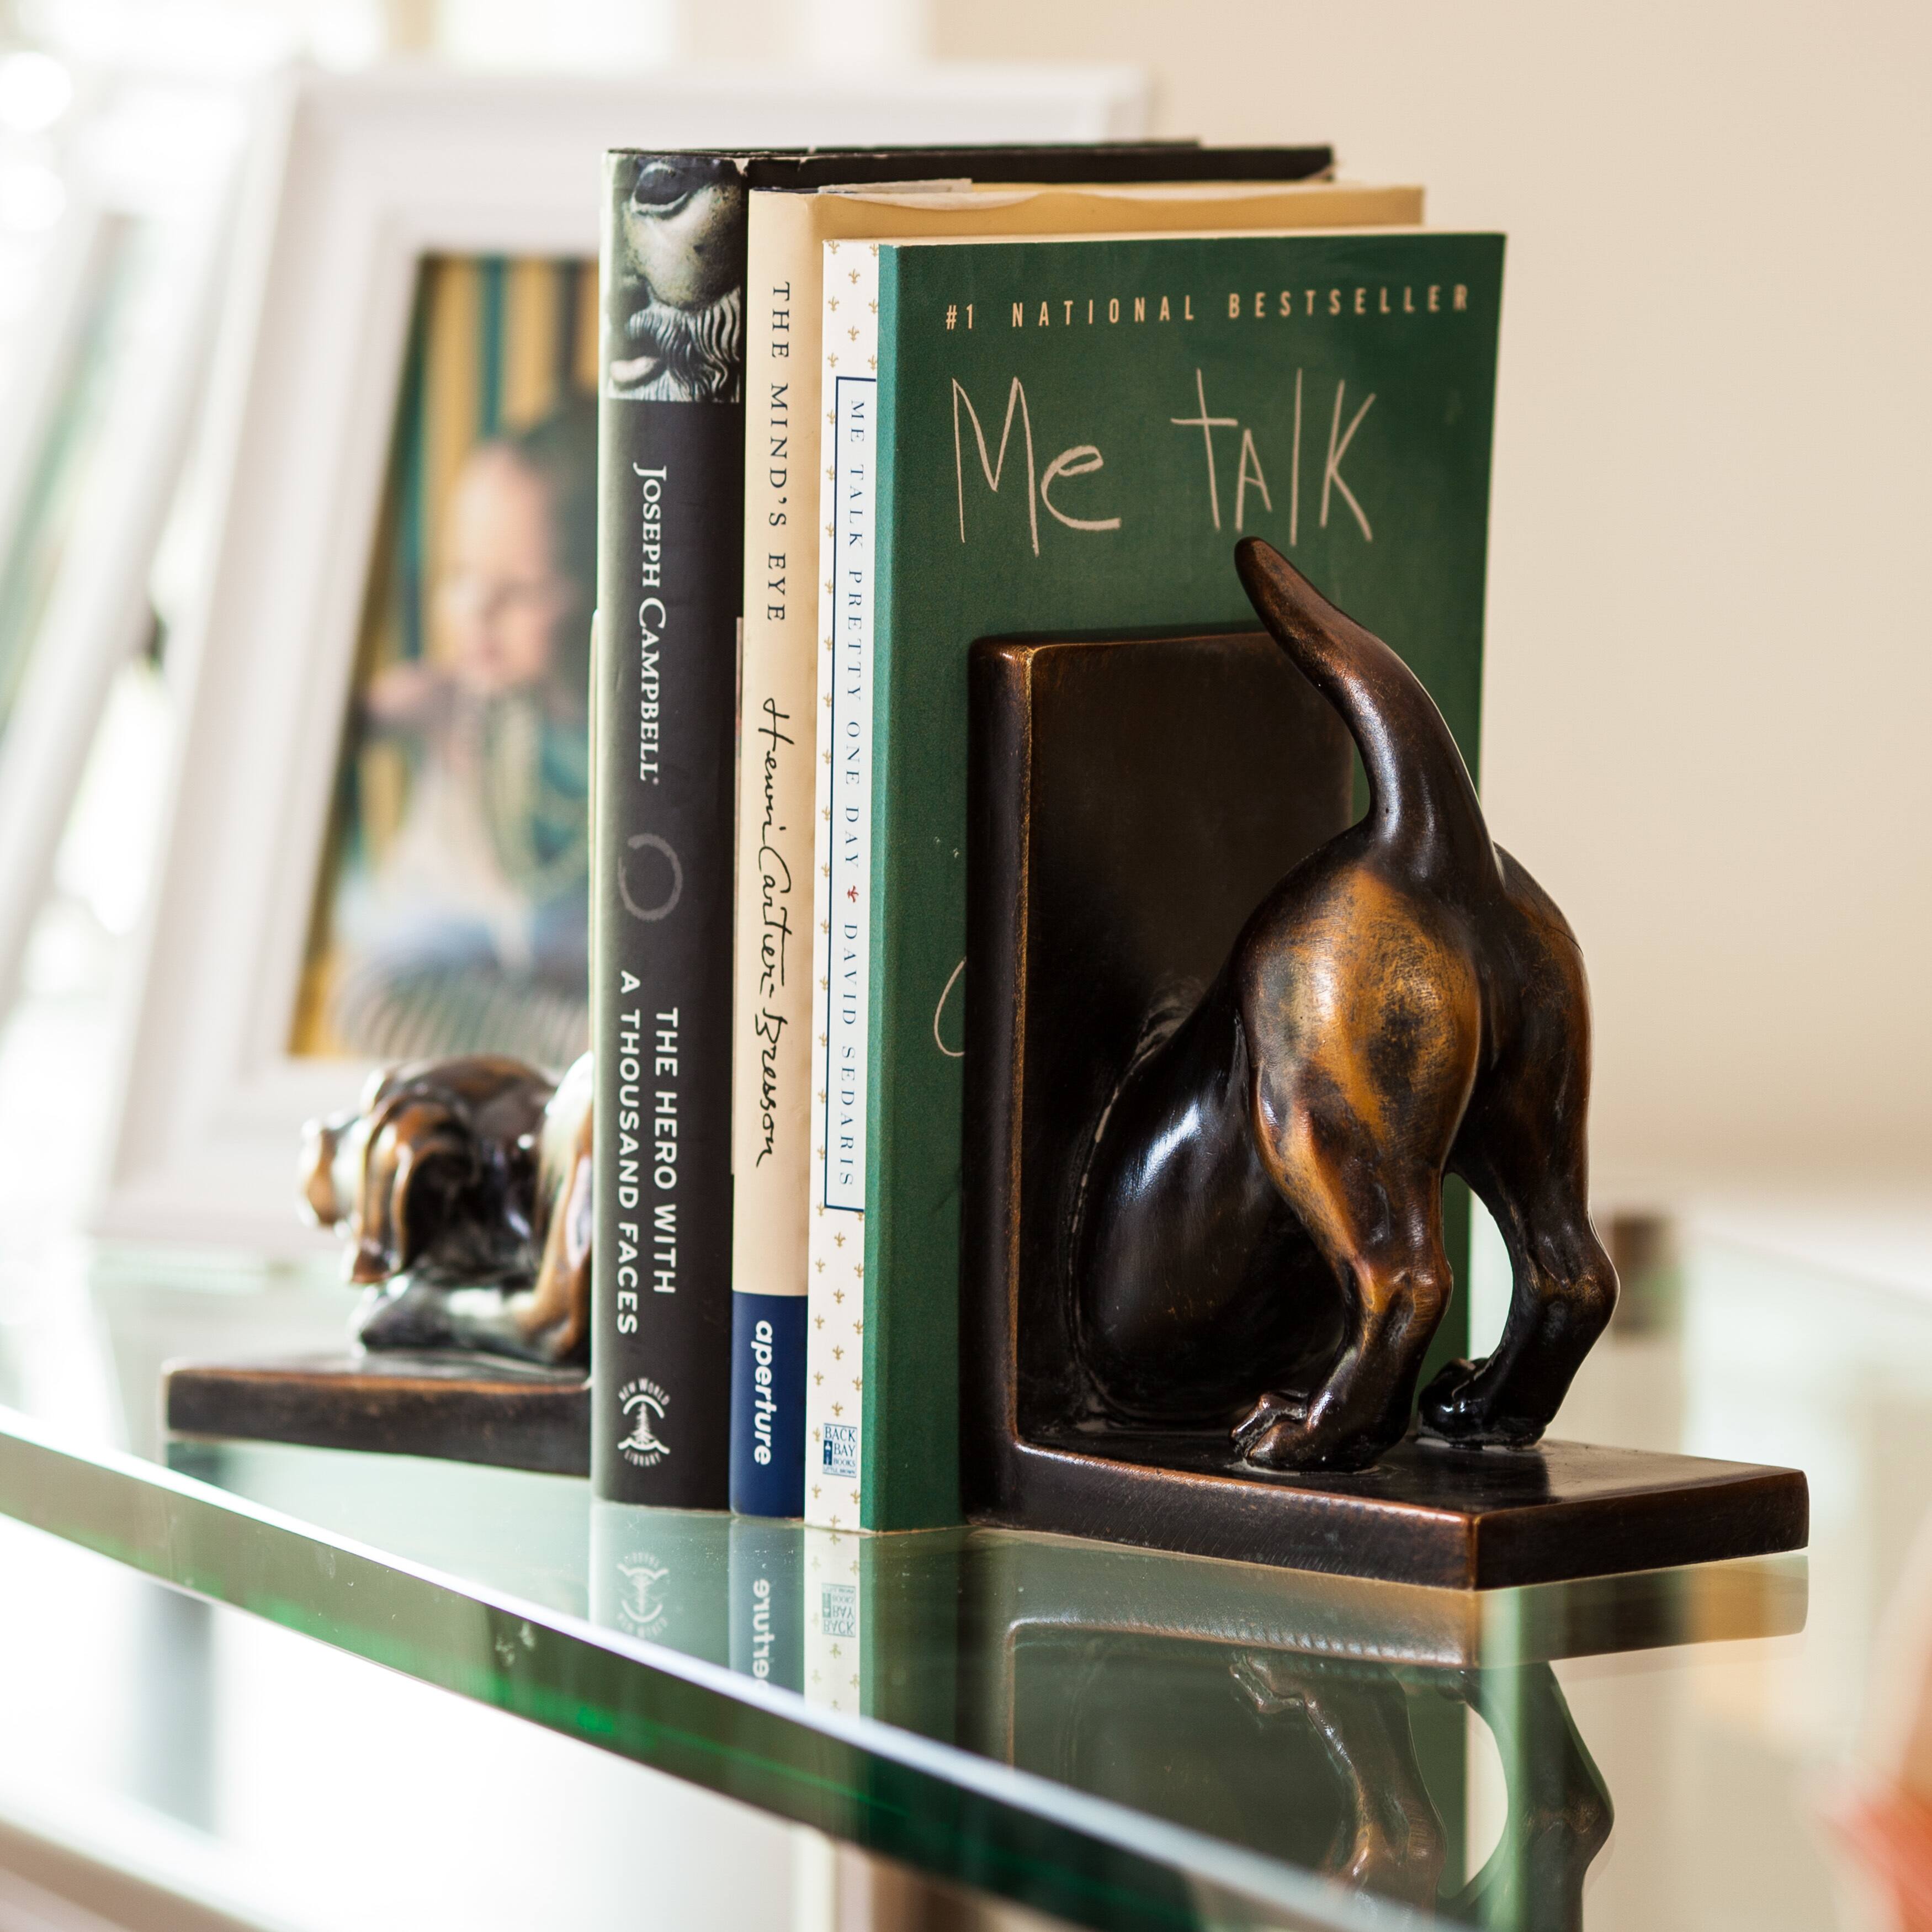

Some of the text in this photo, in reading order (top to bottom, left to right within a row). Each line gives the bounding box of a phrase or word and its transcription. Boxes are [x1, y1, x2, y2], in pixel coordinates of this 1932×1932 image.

[946, 283, 1468, 330] #1 NATIONAL BESTSELLER
[633, 462, 667, 587] JOSEPH
[767, 281, 790, 621] THE MIND'S EYE
[952, 376, 1121, 558] Me
[840, 400, 865, 1186] ME TALK PRETTY ONE DAY DAVID SEDARIS
[617, 970, 641, 1334] A THOUSAND FACES
[653, 1007, 678, 1293] THE HERO WITH
[750, 1320, 777, 1466] aperture
[825, 1426, 856, 1442] BACK
[834, 1442, 856, 1457] BAY
